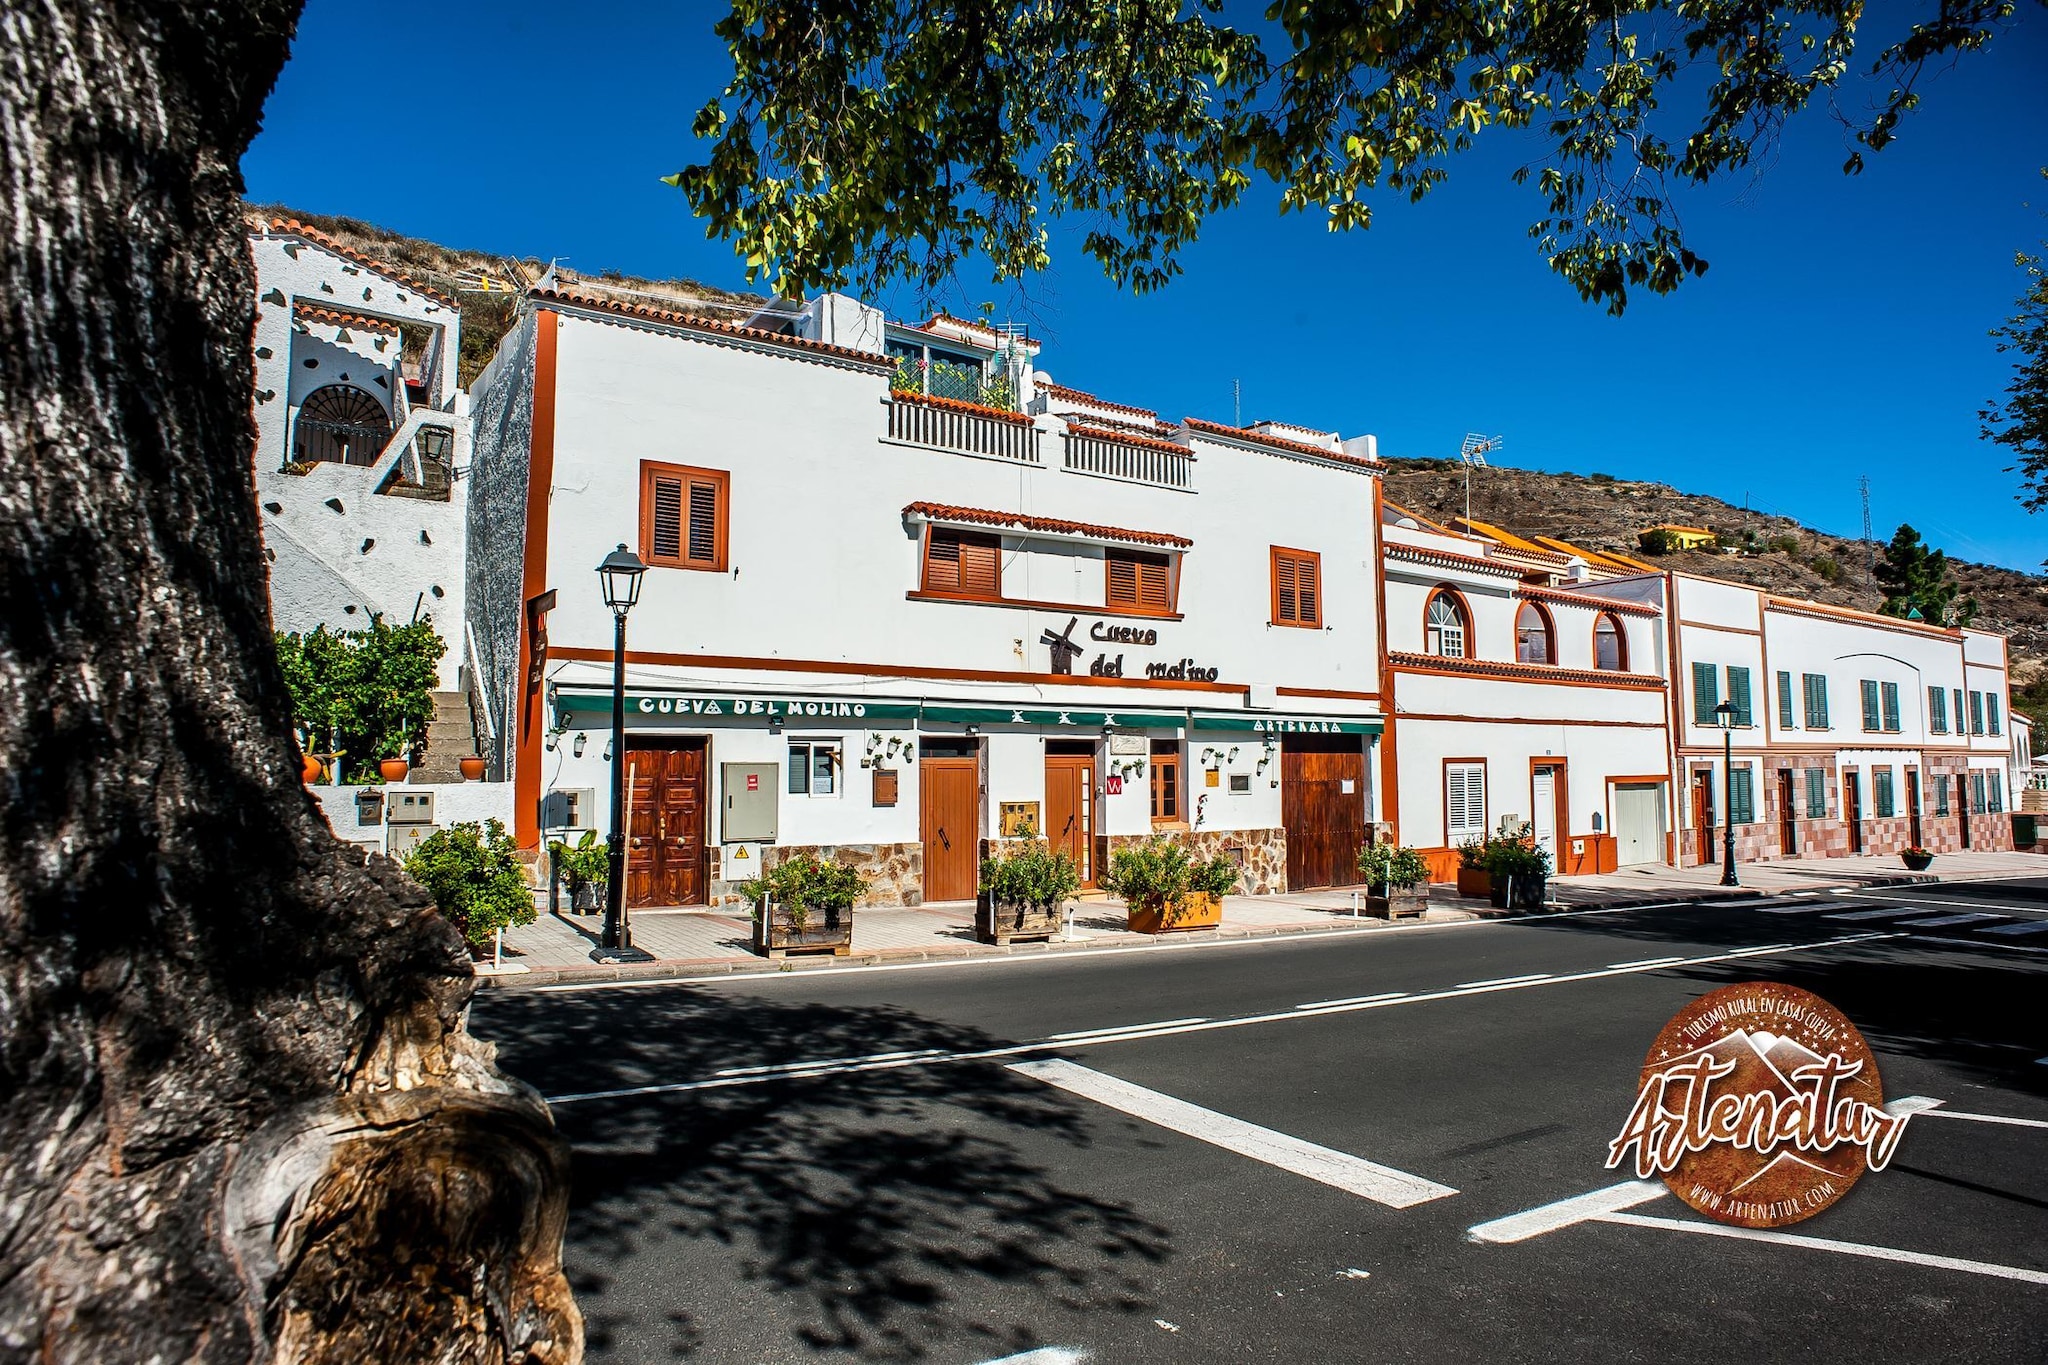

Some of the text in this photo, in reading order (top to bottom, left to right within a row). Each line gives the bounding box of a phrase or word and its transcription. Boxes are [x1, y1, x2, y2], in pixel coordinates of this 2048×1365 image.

[1090, 621, 1157, 645] Cueva
[1090, 653, 1218, 682] del molino
[639, 698, 866, 718] CUEVA DEL MOLINO
[1253, 719, 1341, 733] ARTENARA
